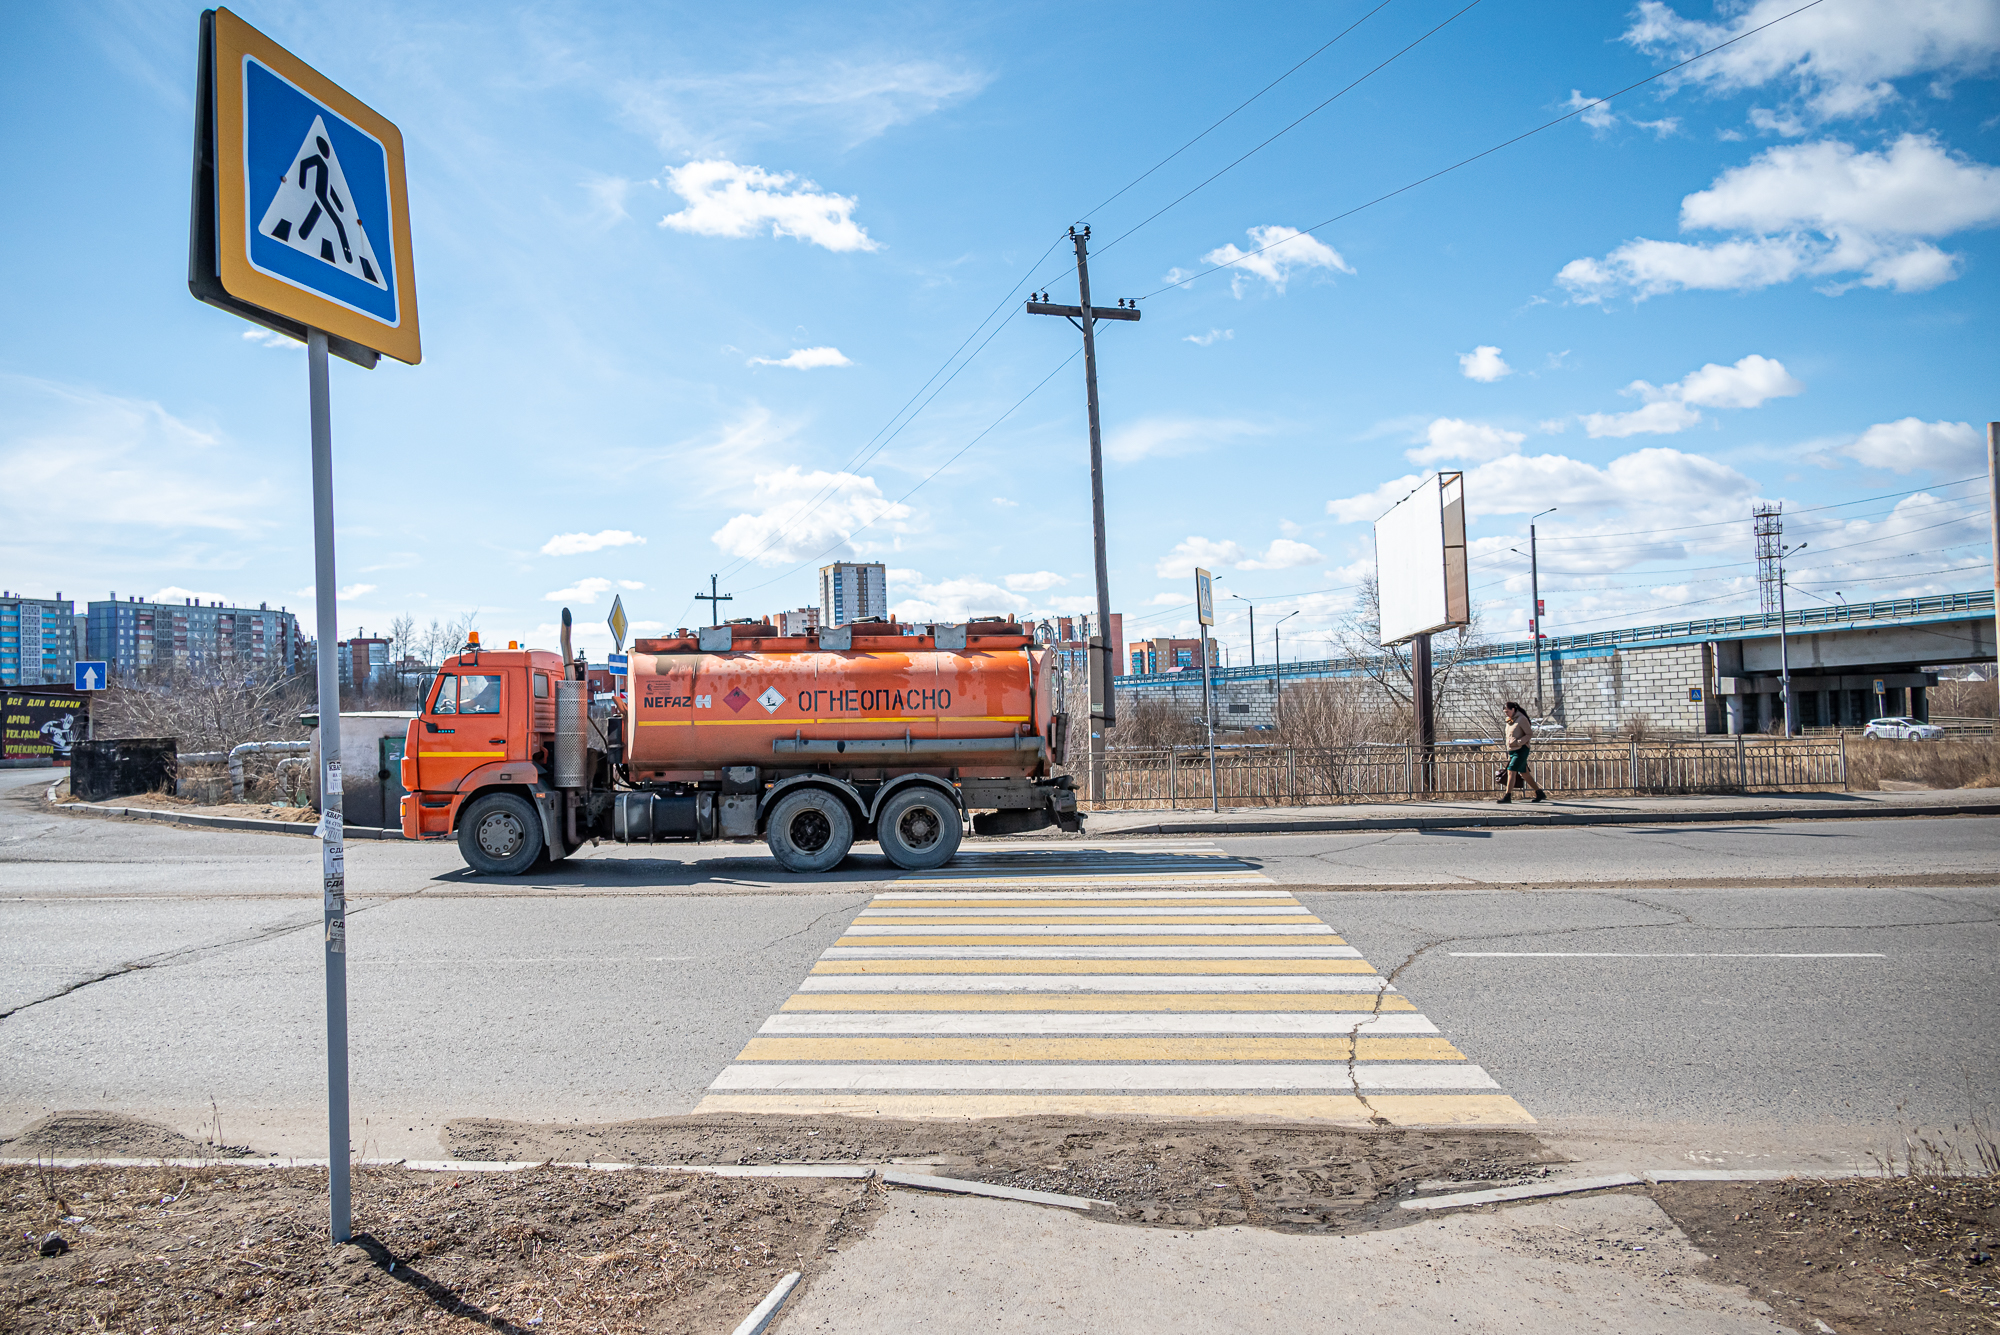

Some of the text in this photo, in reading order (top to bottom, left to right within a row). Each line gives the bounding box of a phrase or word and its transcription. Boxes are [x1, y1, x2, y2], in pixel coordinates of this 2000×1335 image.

[49, 700, 80, 708] СВАРКИ
[644, 696, 691, 708] NEFAZ
[798, 688, 951, 712] ОГНЕОПАСНО
[5, 745, 54, 754] УГЛЕКИСЛОТА
